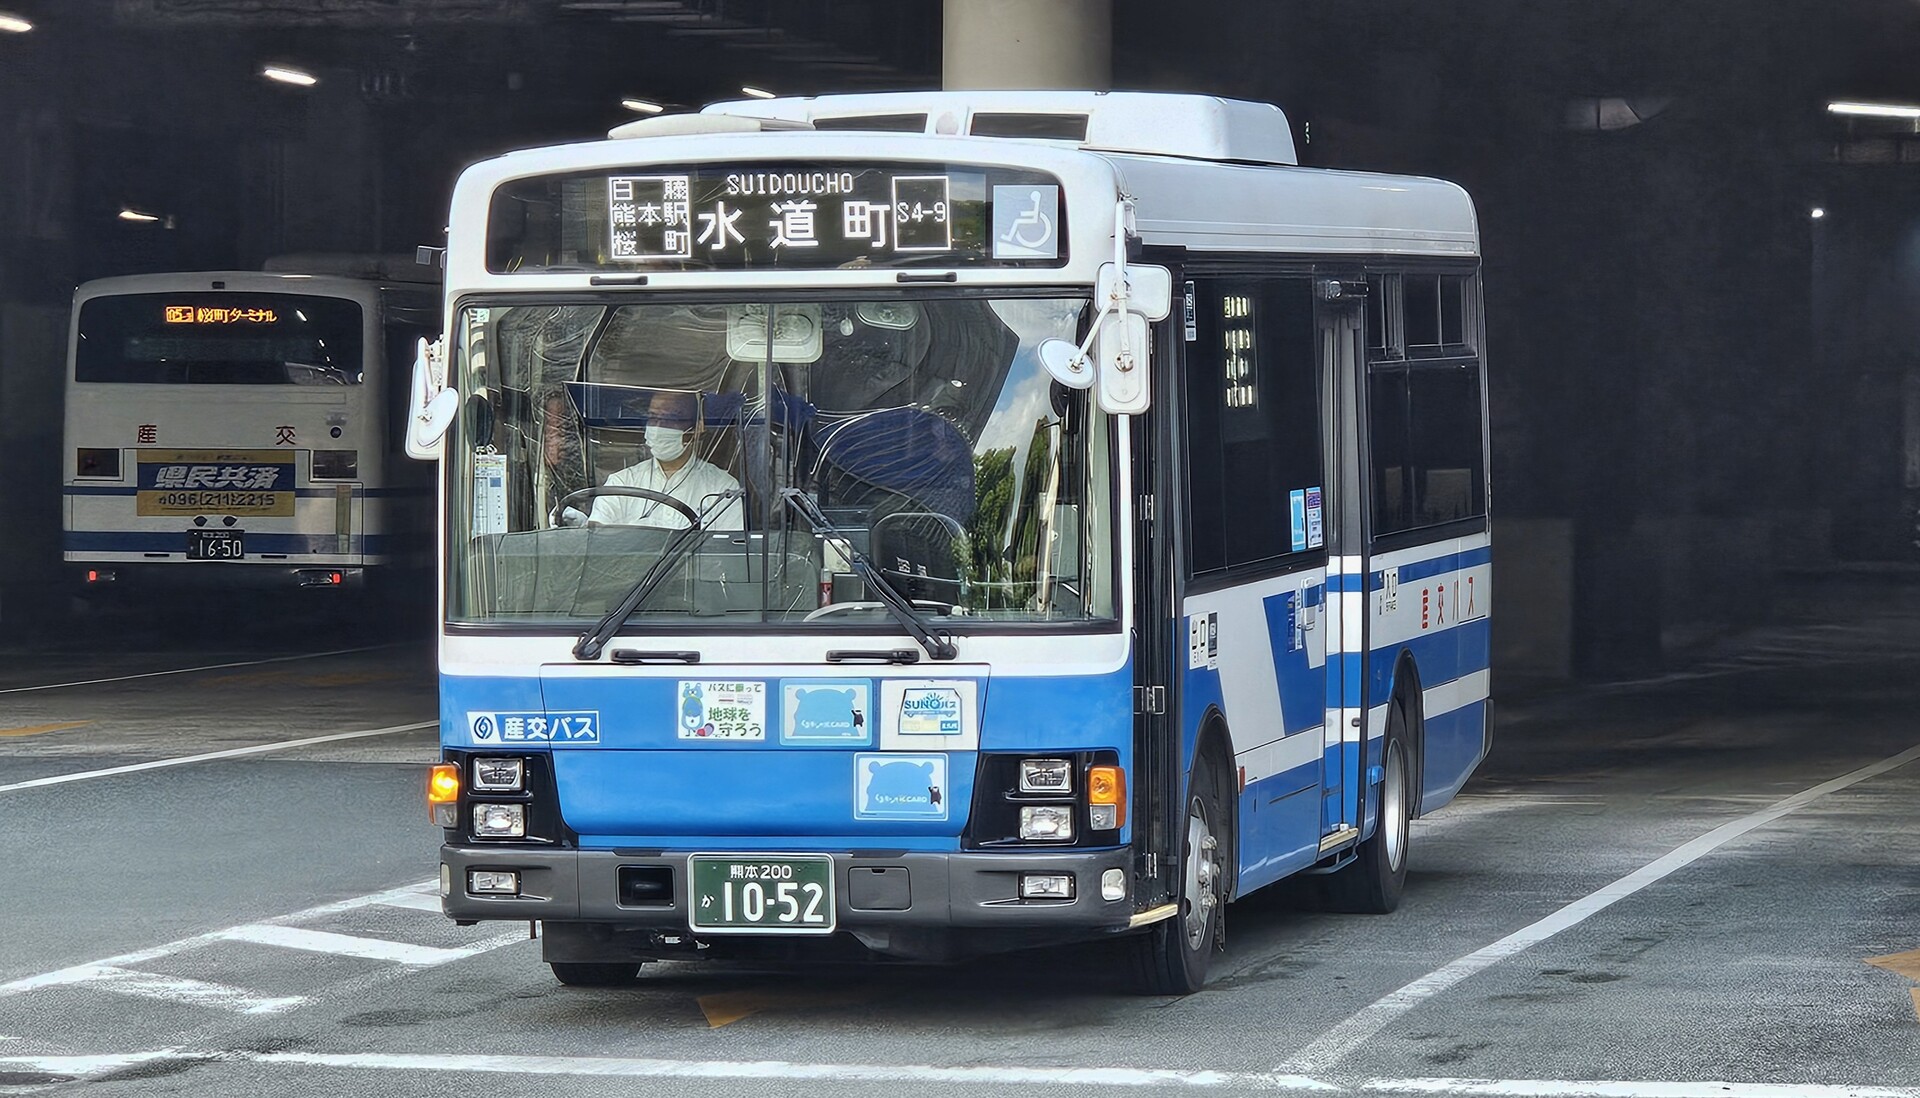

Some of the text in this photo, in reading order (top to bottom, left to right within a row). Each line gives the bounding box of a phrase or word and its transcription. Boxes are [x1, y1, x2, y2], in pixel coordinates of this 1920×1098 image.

[727, 173, 854, 195] SUIDOUCHO
[612, 202, 688, 227] 熊本駅
[897, 202, 946, 222] S4-9
[697, 200, 891, 250] 水道町
[154, 465, 280, 489] 県民共済
[200, 539, 242, 557] 16-50
[708, 707, 751, 722] 地球を
[504, 717, 596, 739] 産交バス
[718, 722, 761, 737] 守ろう
[730, 864, 792, 879] 熊本200
[701, 881, 824, 922] か 10-52
